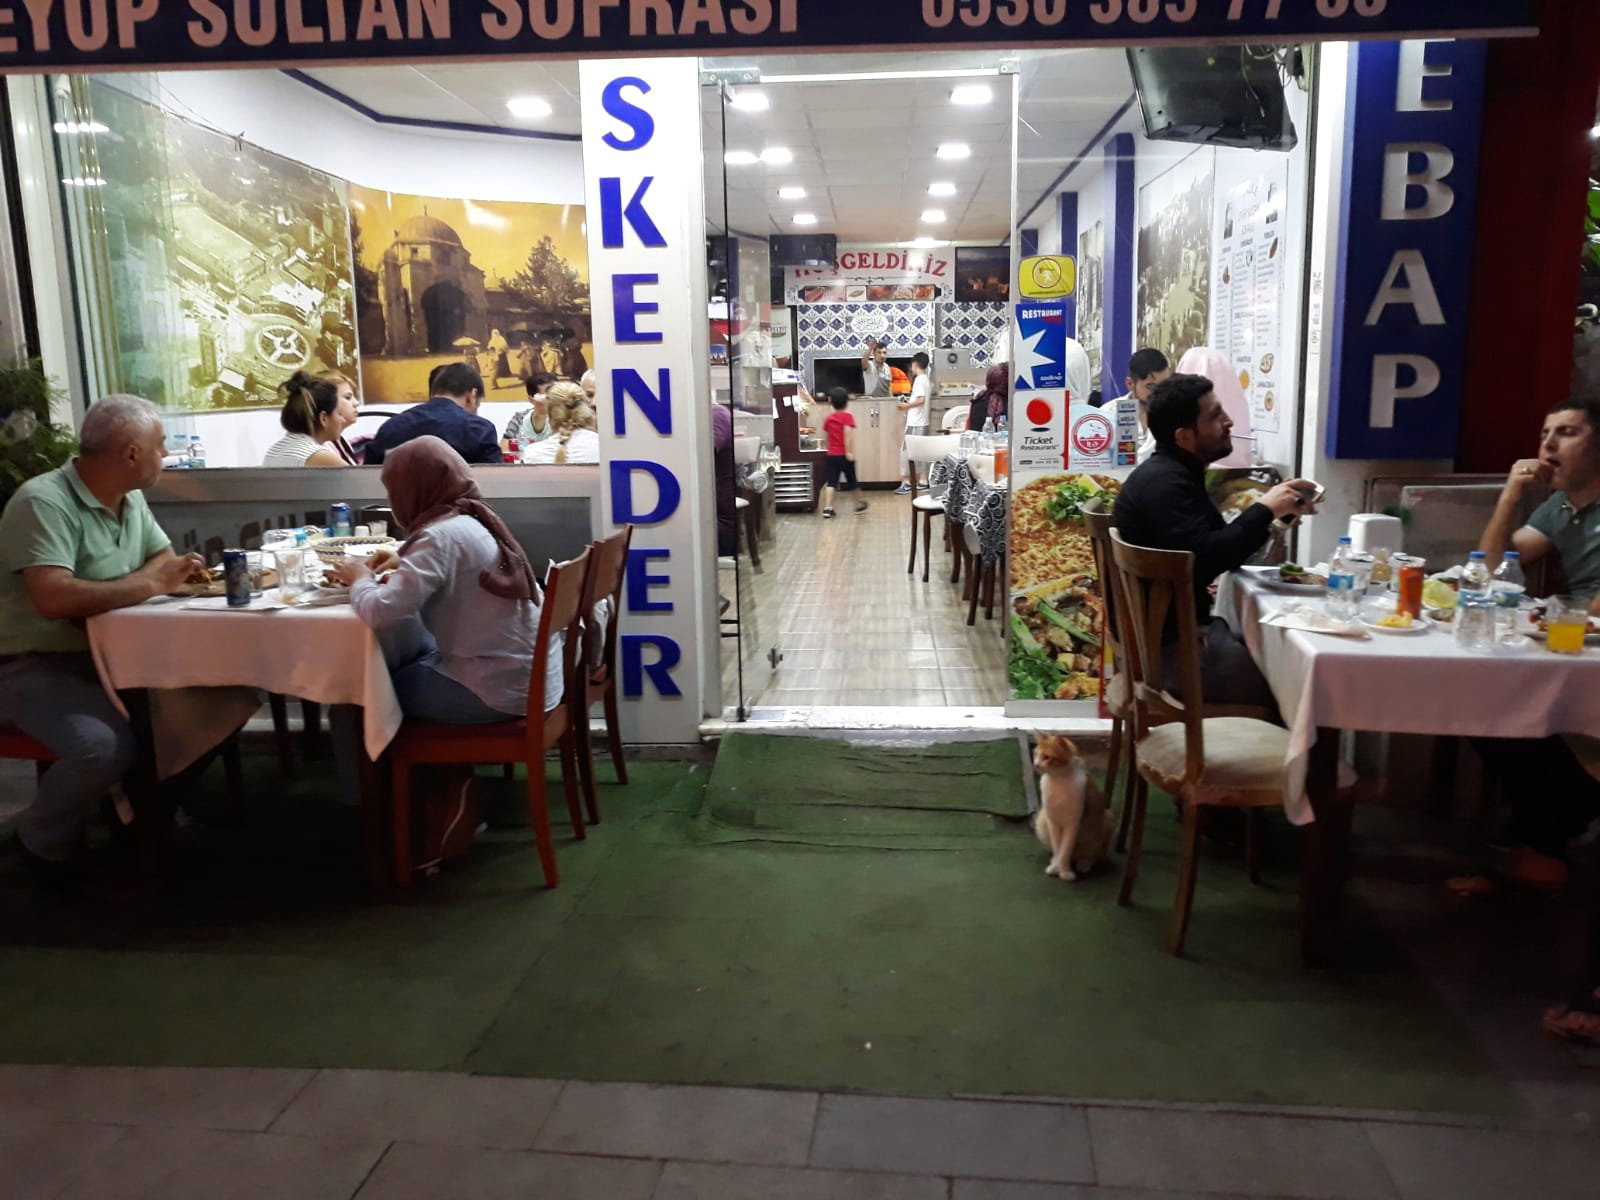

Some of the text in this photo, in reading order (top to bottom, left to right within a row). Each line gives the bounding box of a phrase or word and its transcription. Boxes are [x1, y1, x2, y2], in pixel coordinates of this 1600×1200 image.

[187, 0, 450, 47] SULTAN
[599, 76, 682, 697] SKENDER
[1024, 436, 1054, 445] Ticket
